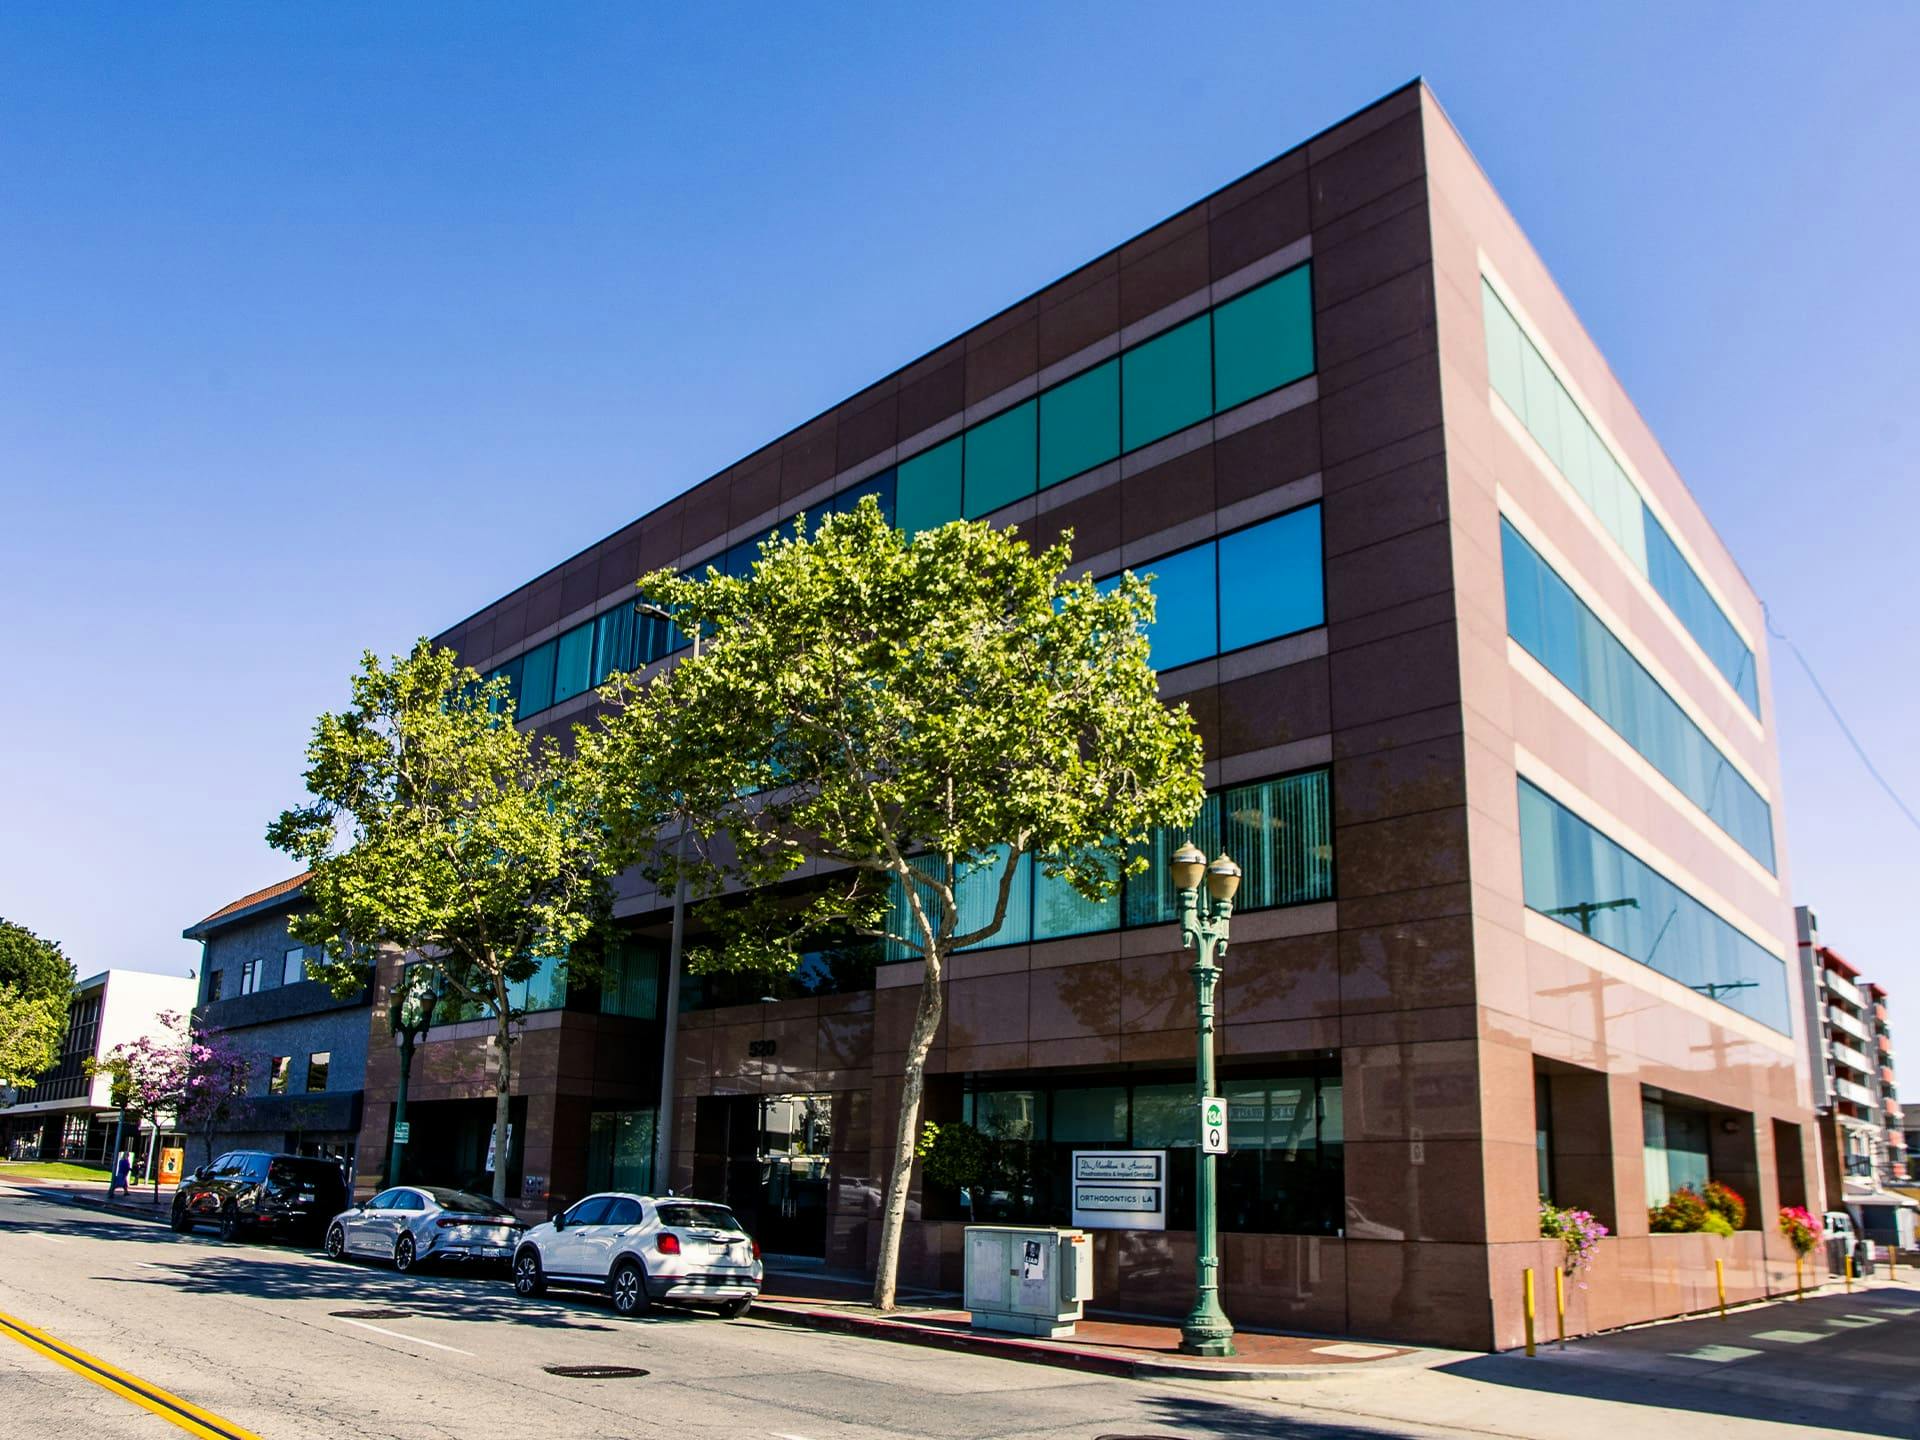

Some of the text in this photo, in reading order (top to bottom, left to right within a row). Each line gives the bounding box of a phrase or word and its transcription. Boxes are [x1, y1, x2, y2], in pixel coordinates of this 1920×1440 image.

[749, 1040, 776, 1057] 520
[1207, 1110, 1222, 1123] 134
[1080, 1195, 1153, 1203] ORTHODONTICS LA
